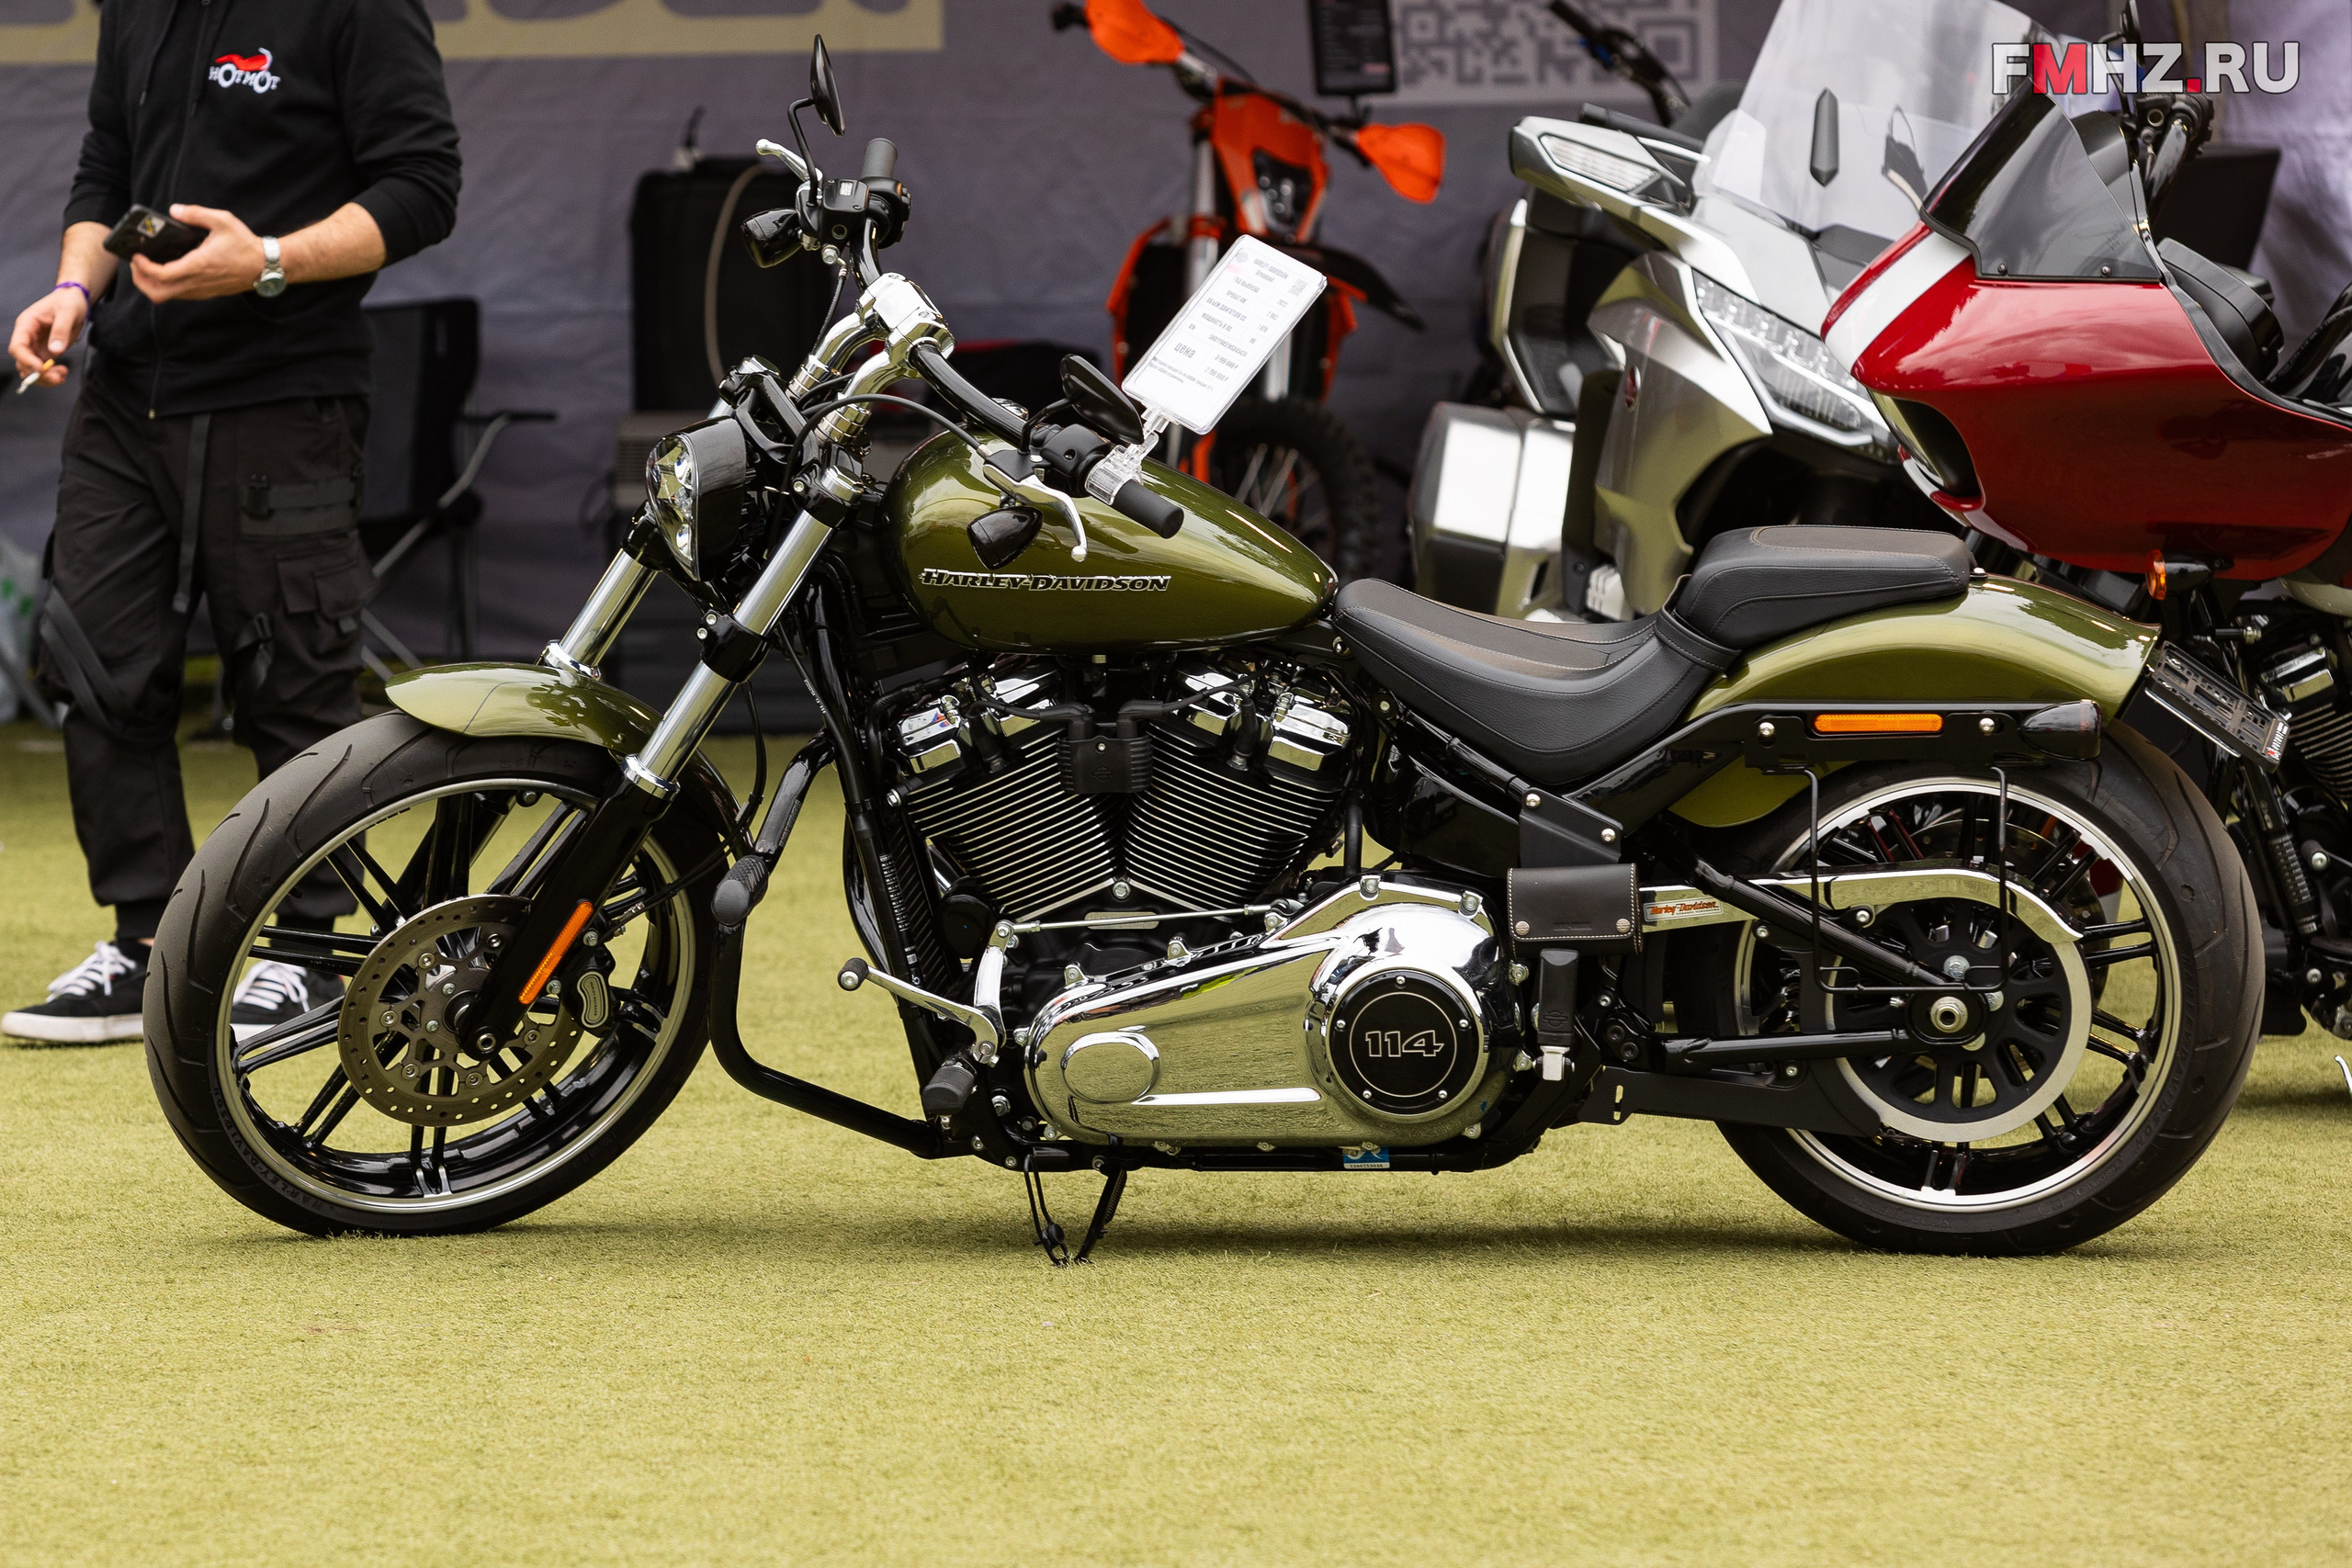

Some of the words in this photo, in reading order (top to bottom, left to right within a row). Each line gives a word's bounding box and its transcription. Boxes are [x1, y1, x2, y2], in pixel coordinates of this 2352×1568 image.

[208, 62, 280, 94] HOTMOT
[1173, 342, 1196, 360] цена
[919, 568, 1171, 591] HARLEY-DAVIDSON
[1365, 1030, 1444, 1057] 114
